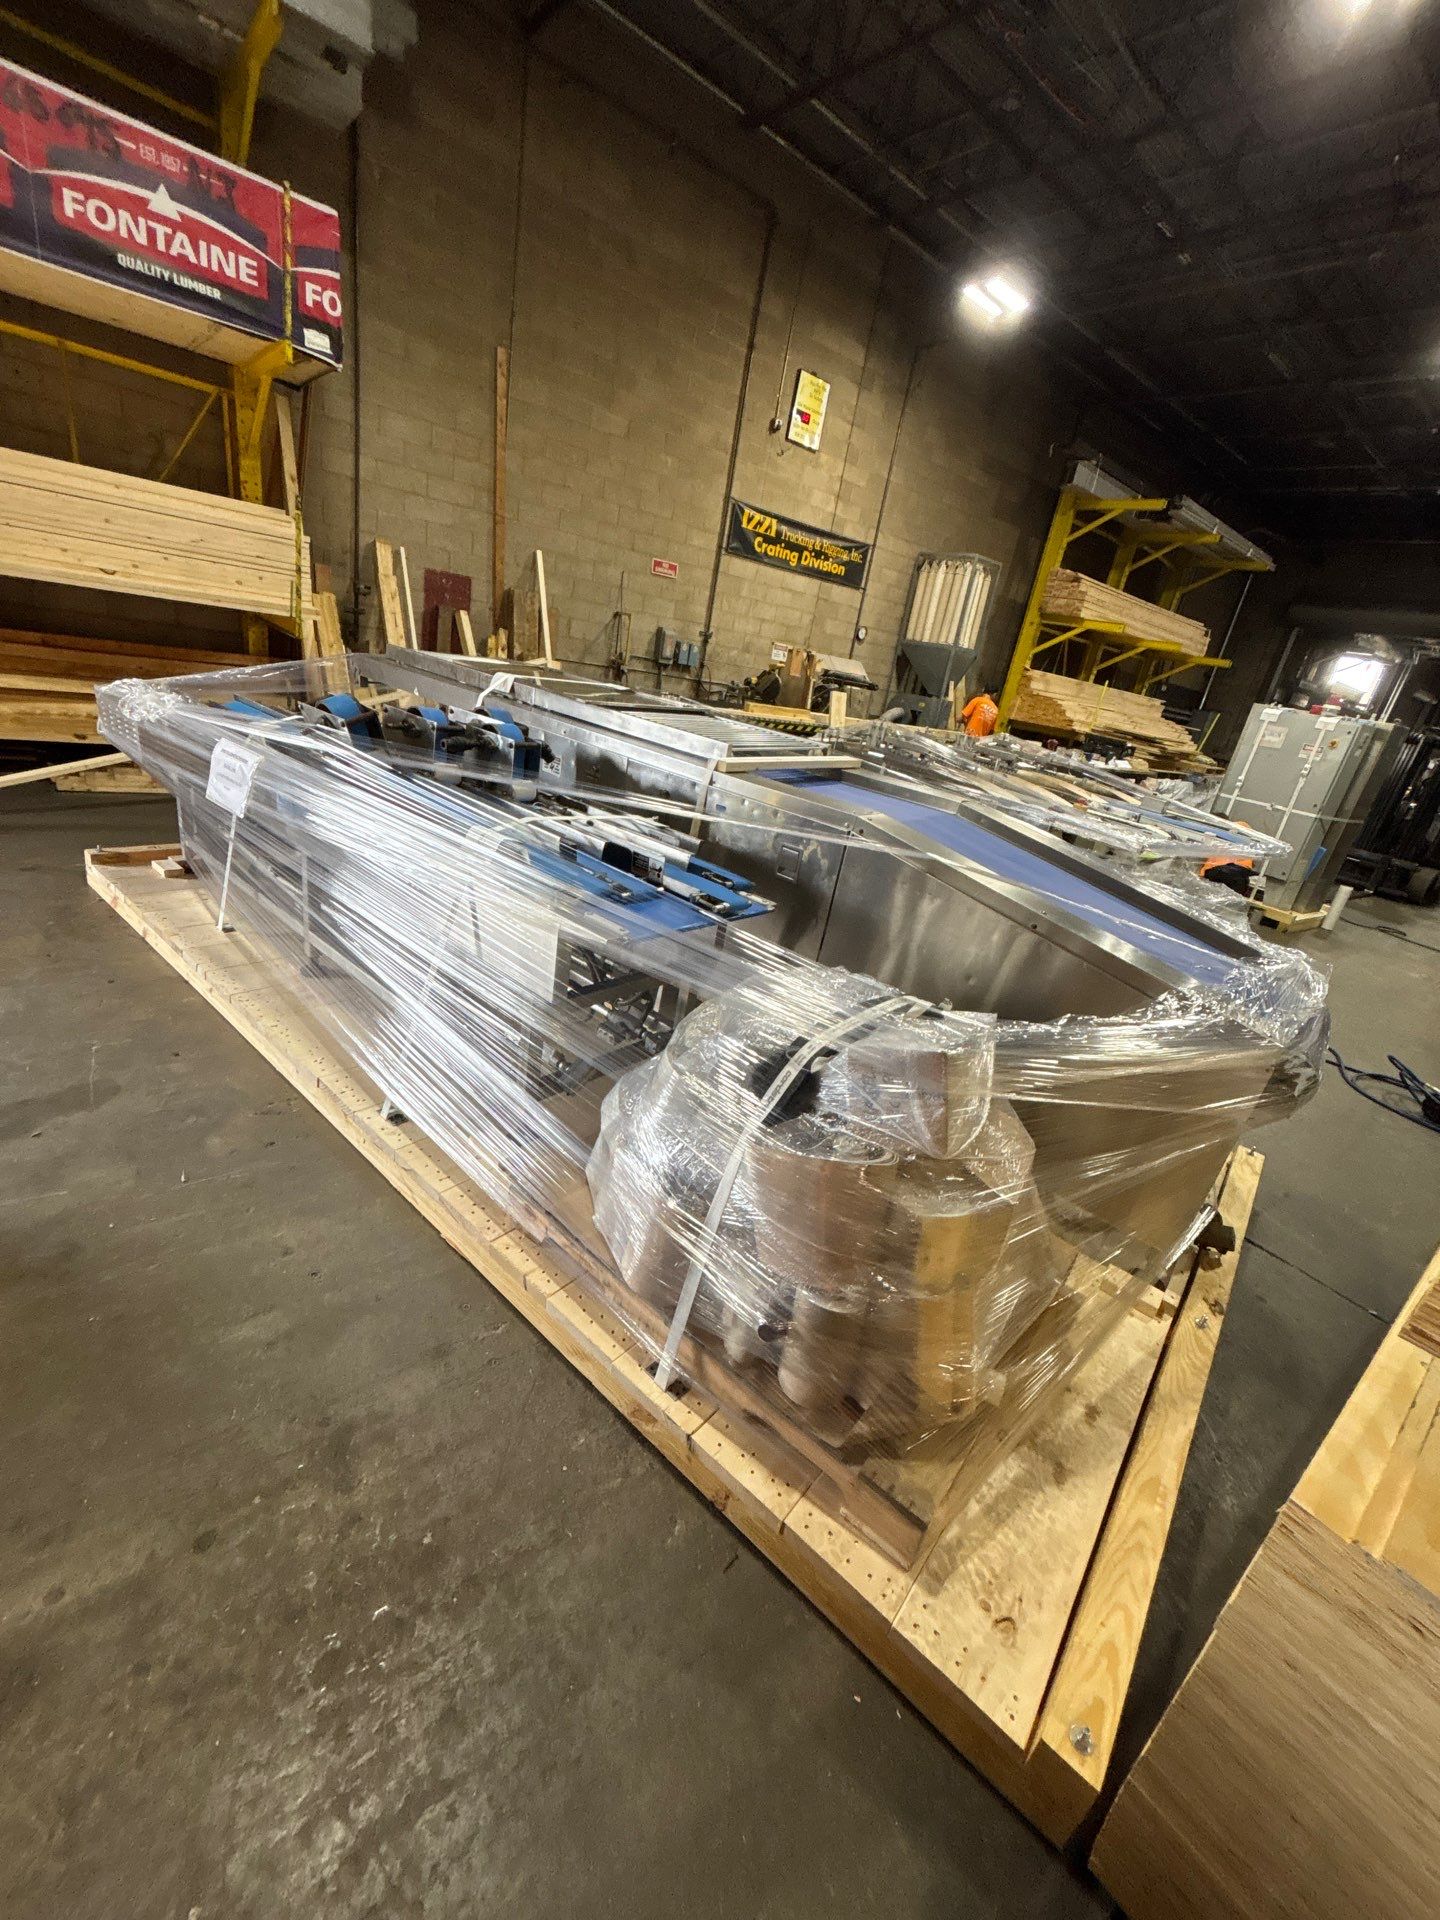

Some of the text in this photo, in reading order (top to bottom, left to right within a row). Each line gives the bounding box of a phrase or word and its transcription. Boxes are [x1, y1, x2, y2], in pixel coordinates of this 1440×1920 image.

[61, 187, 259, 288] FONTAINE
[116, 253, 222, 301] QUALITY LUMBER
[305, 281, 342, 317] FO
[754, 536, 846, 576] Crating Division
[781, 525, 814, 550] Trucking
[814, 536, 821, 550] &
[851, 548, 863, 563] Inc.
